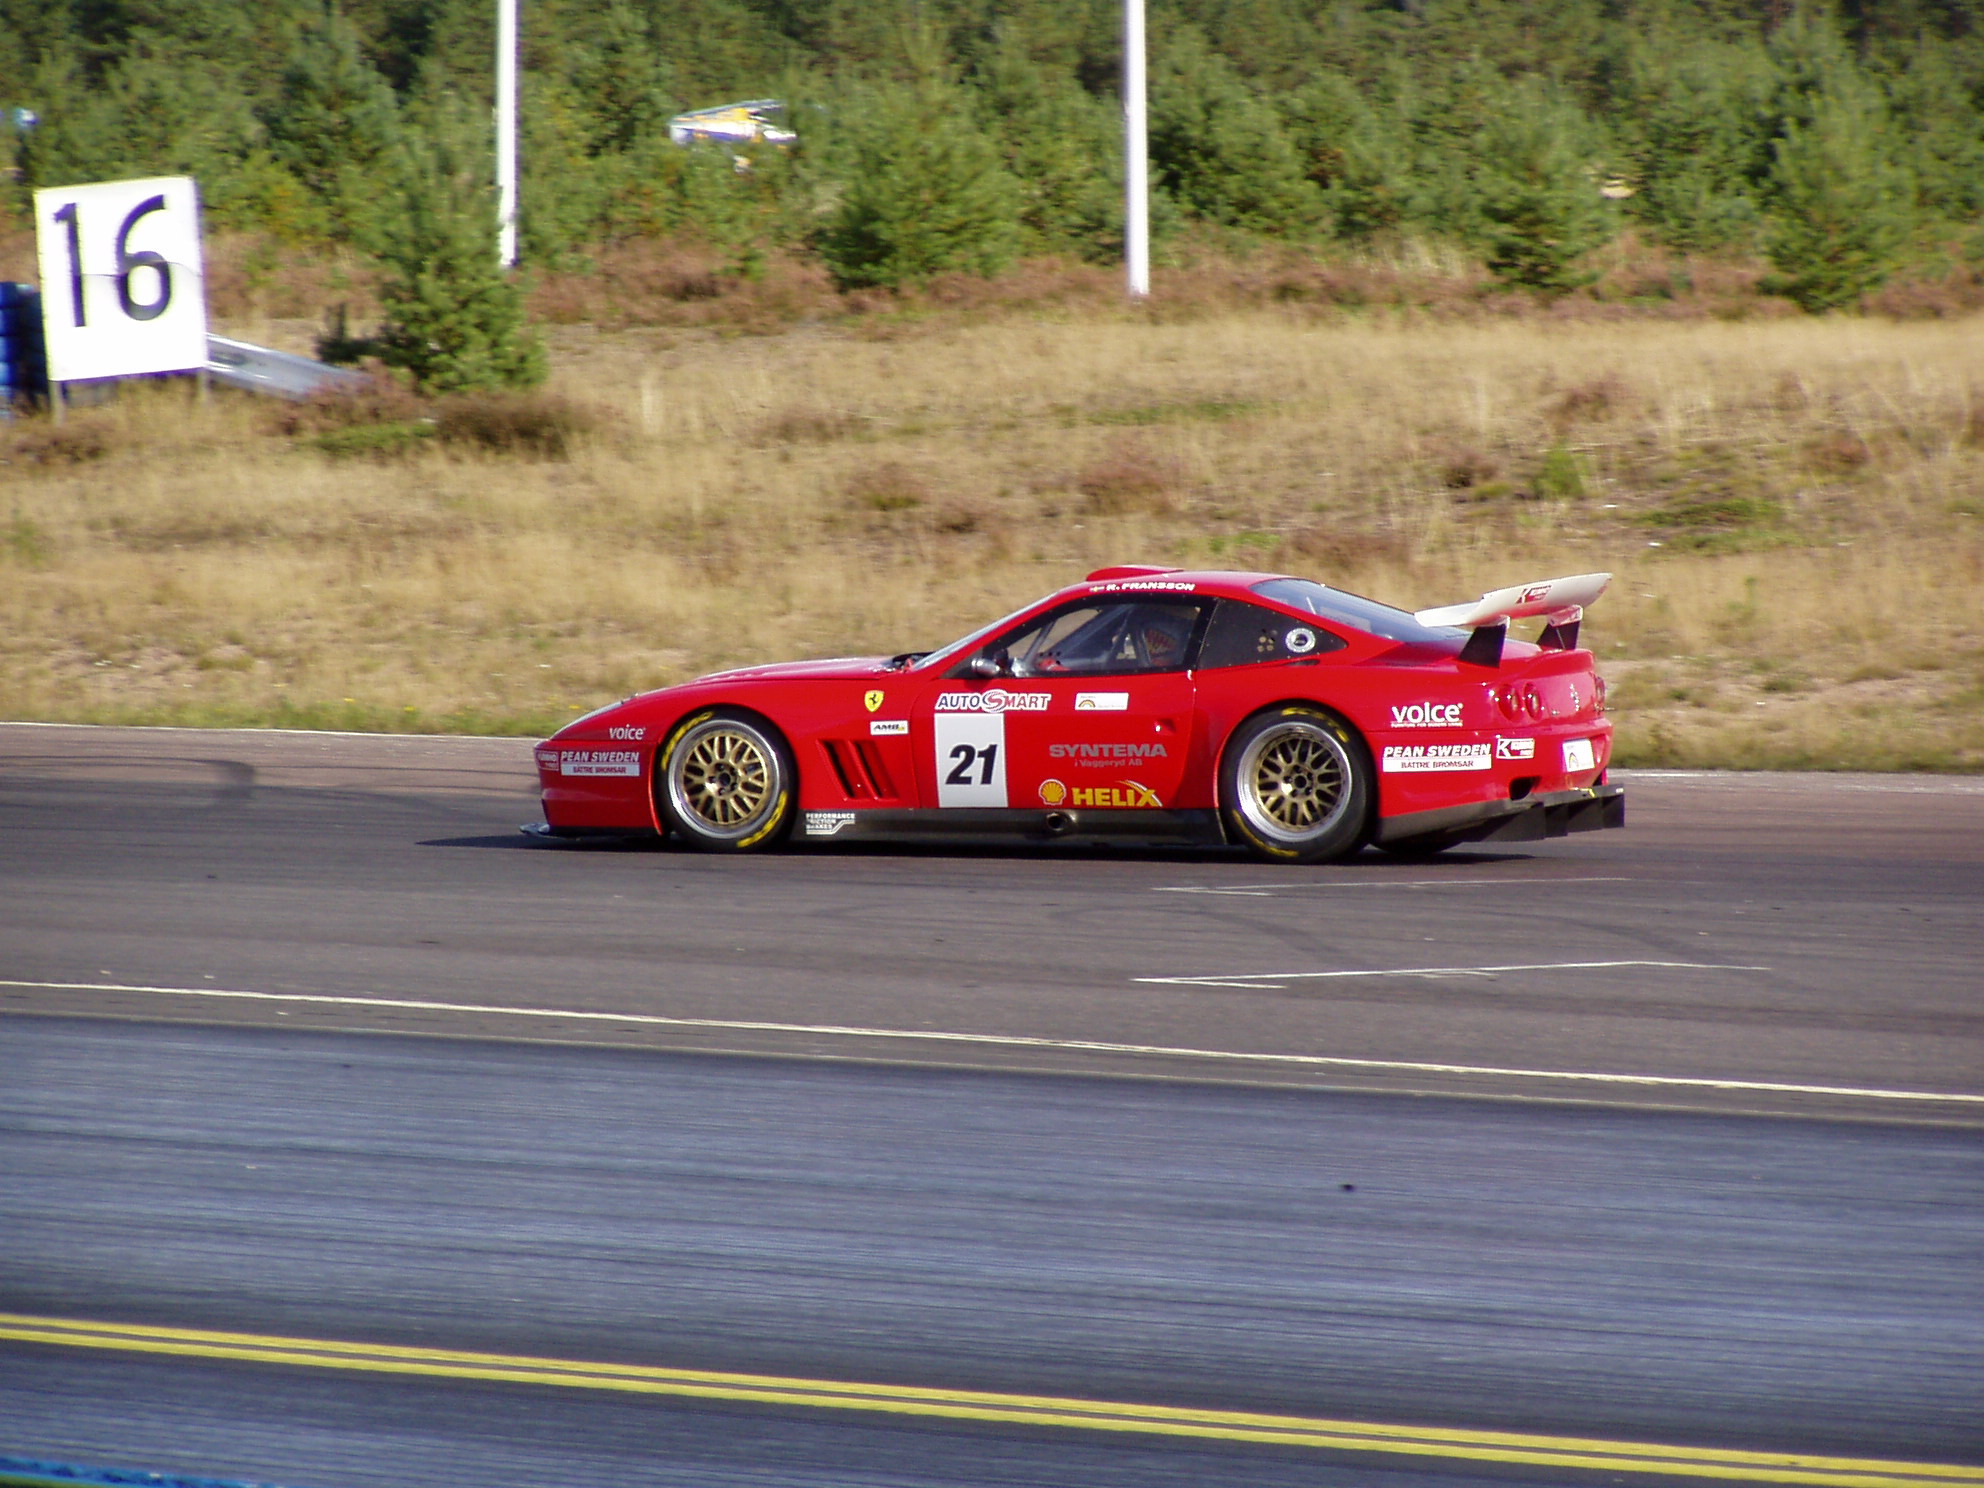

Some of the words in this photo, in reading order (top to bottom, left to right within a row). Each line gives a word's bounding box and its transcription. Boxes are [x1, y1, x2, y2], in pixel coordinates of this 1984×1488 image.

[53, 193, 171, 328] 16
[1106, 583, 1120, 591] R.
[1121, 582, 1195, 591] FRANSSON
[937, 690, 1050, 712] AUTOSMART
[1391, 702, 1460, 723] voice
[609, 724, 644, 740] voice
[561, 751, 589, 761] PEAN
[591, 751, 640, 762] SWEDEN
[1049, 744, 1168, 758] SYNTEMA
[1384, 745, 1425, 757] PEAN
[1427, 743, 1491, 757] SWEDEN
[945, 744, 998, 785] 21
[1128, 758, 1143, 767] AB
[1071, 787, 1162, 807] HELIX
